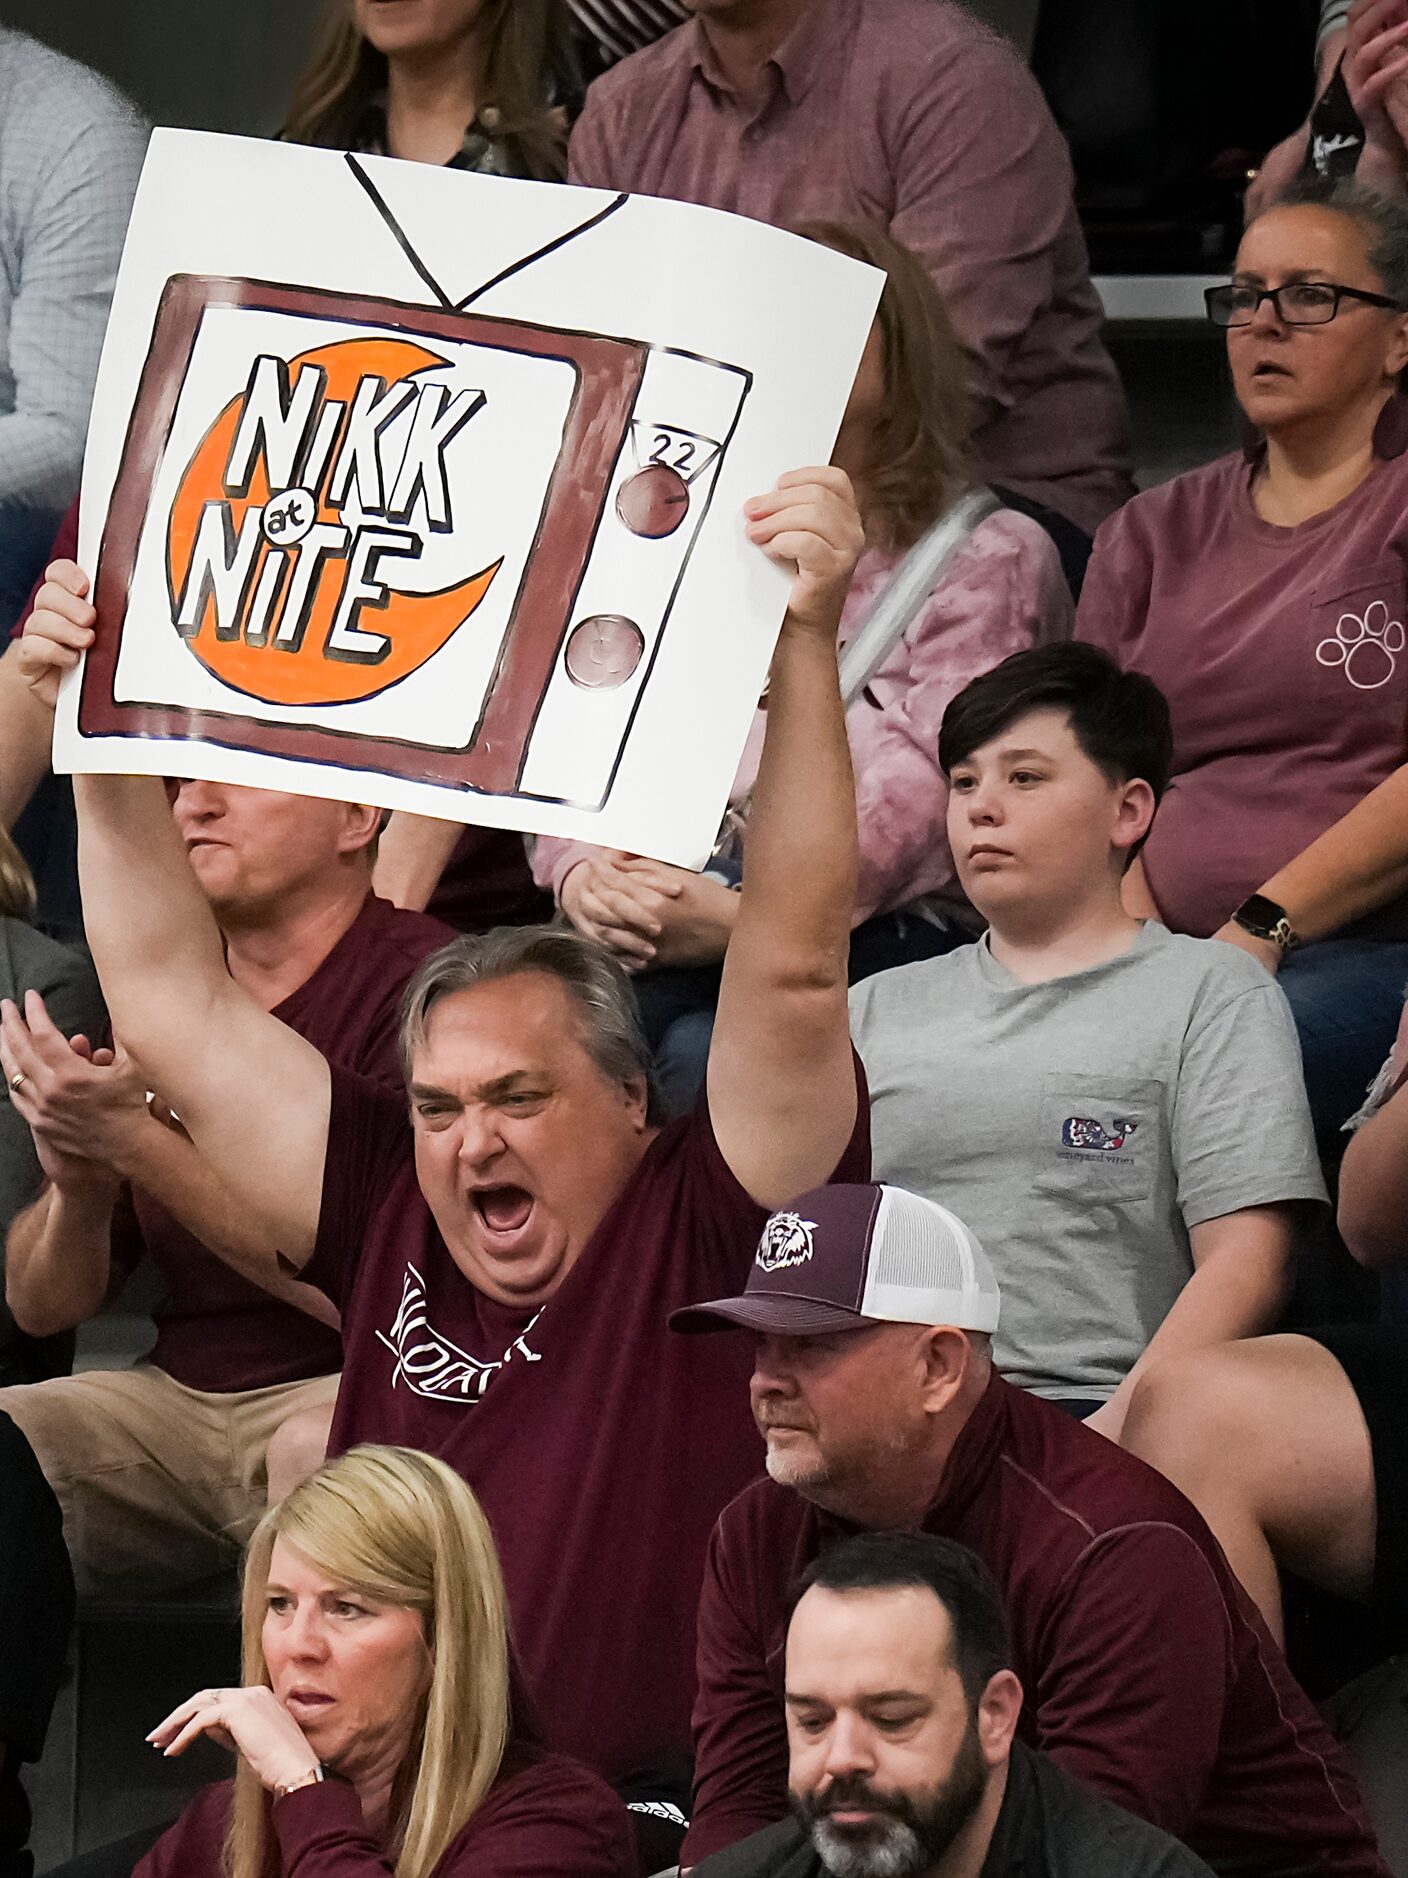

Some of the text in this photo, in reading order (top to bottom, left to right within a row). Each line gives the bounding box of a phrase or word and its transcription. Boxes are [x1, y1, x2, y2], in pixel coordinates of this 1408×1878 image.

[223, 354, 488, 534] NIKK
[649, 434, 695, 470] 22
[267, 499, 306, 535] at
[171, 500, 425, 666] NITE
